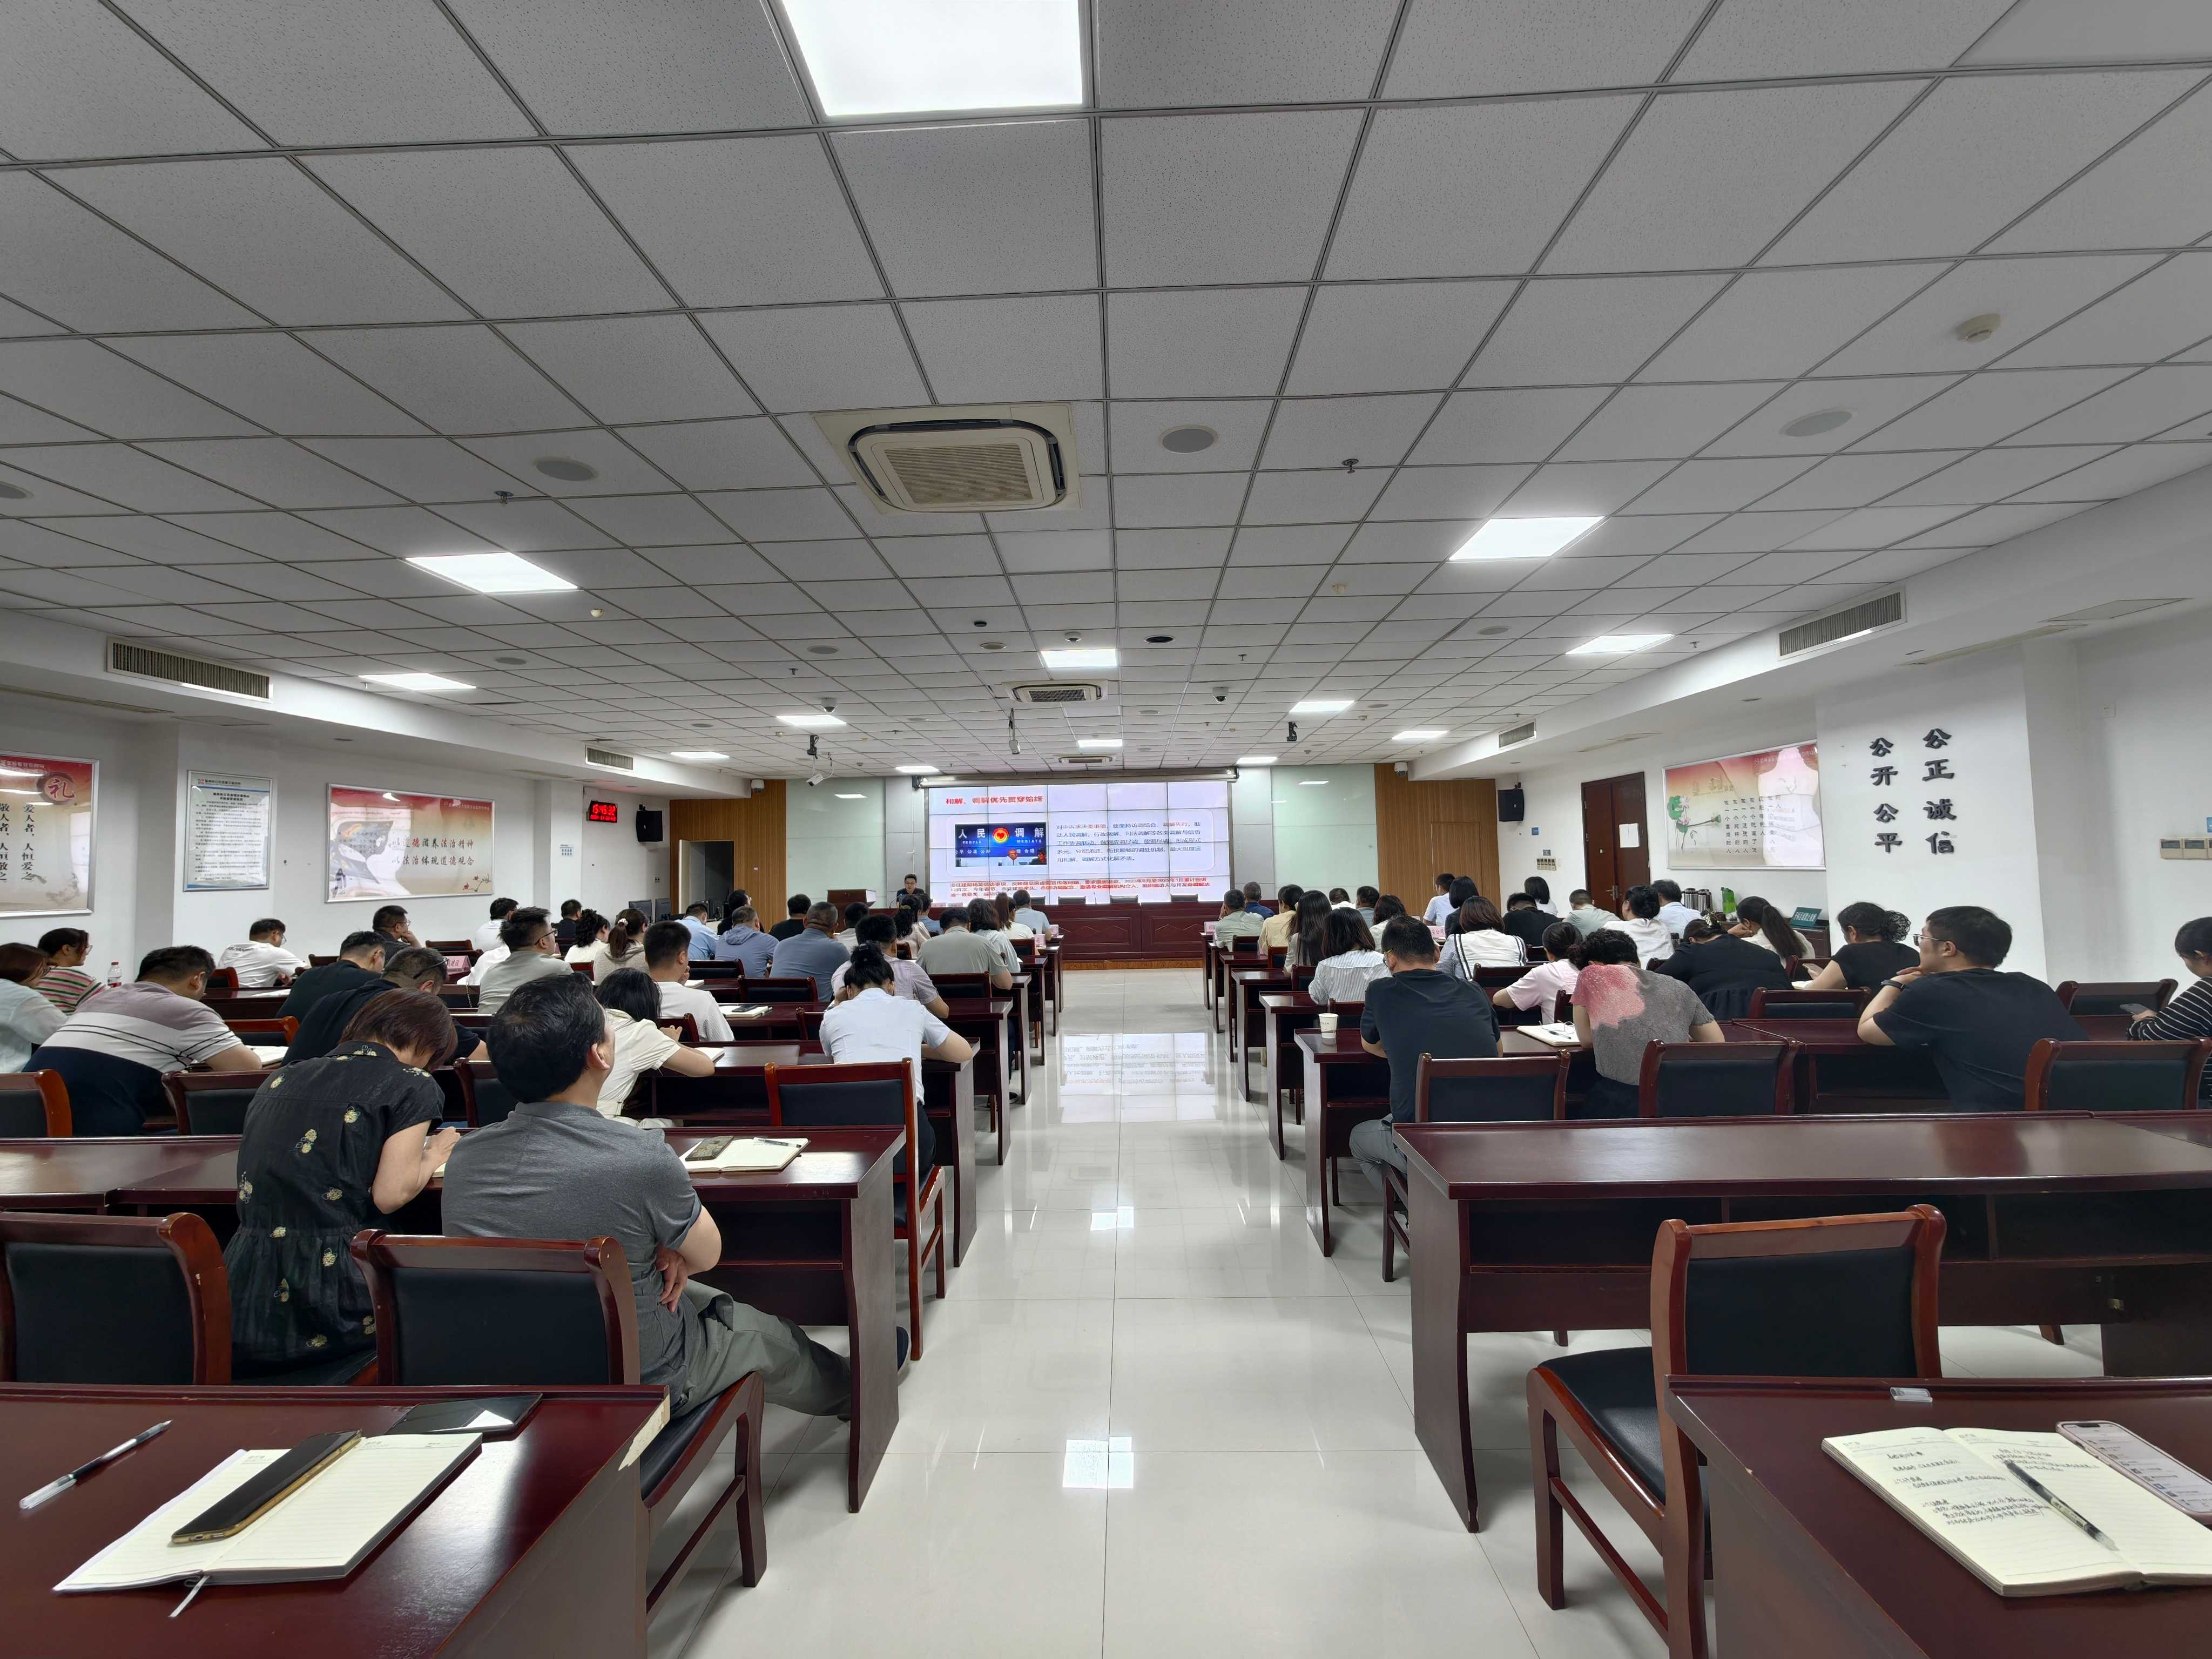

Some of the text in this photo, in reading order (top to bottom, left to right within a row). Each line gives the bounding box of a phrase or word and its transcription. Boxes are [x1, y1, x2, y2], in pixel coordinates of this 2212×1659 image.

[47, 778, 76, 799] 礼
[1869, 737, 1903, 854] 公开 公平
[1922, 728, 1957, 855] 公正 诚信
